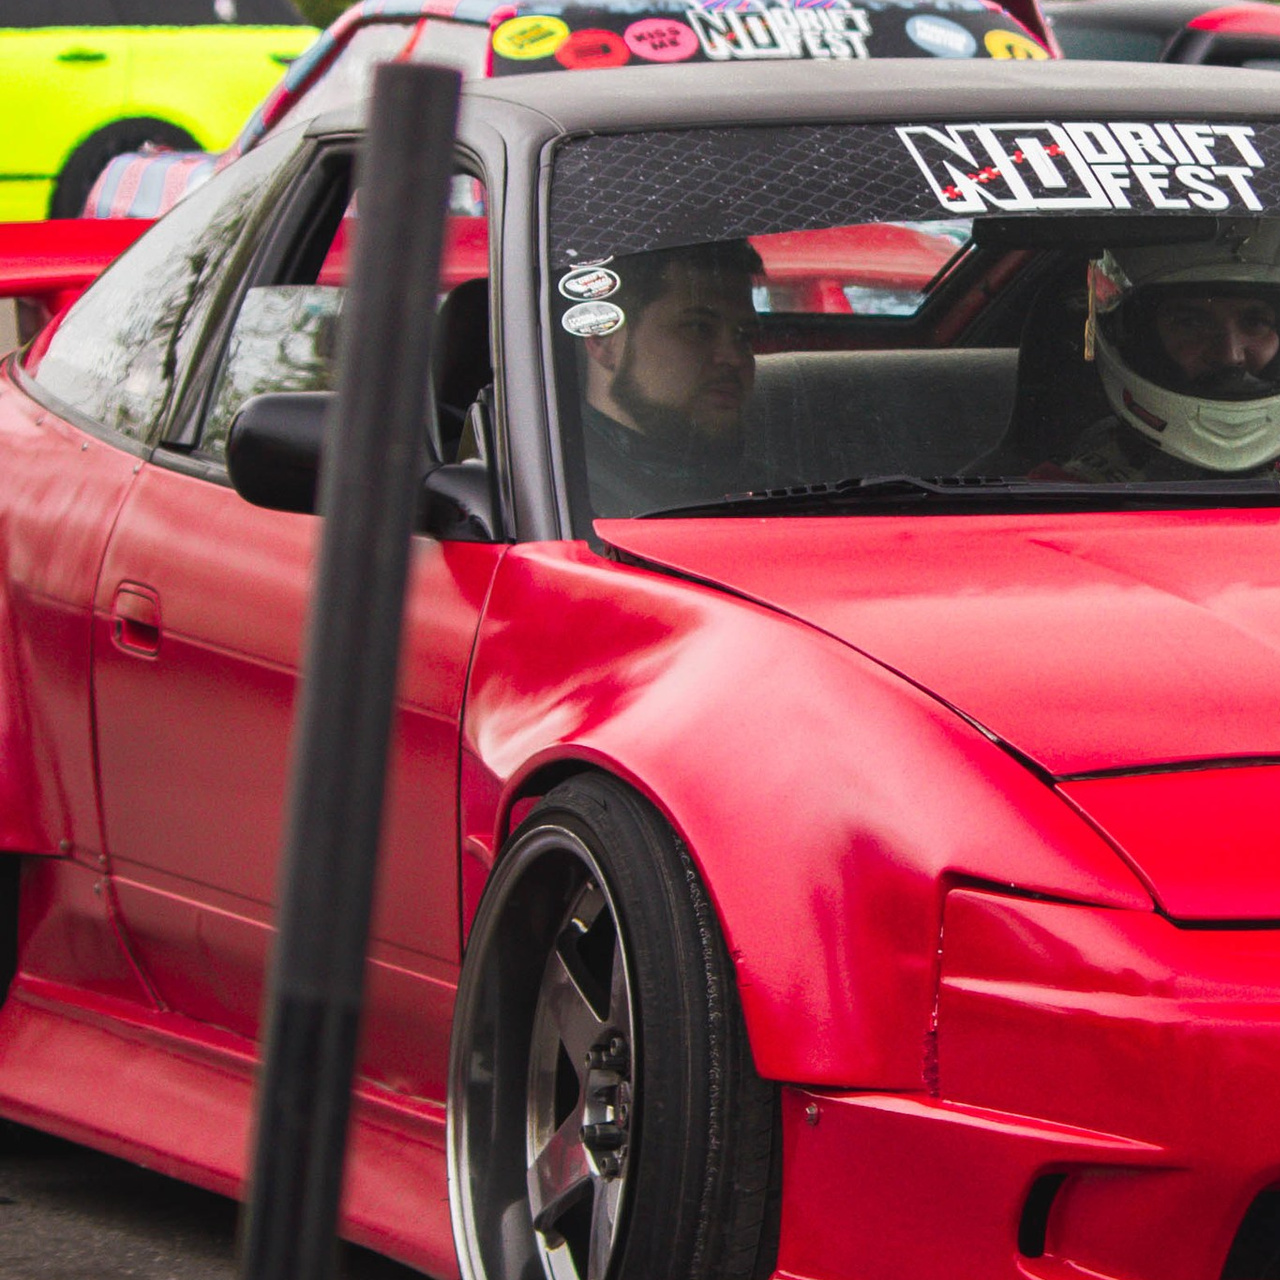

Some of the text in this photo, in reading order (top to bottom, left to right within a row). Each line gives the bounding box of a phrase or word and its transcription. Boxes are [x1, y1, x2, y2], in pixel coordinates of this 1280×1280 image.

[633, 27, 681, 43] KISS
[771, 7, 873, 36] DRIFT
[650, 37, 681, 51] ME
[782, 31, 870, 61] FEST
[895, 122, 1266, 213] NO DRIFT
[1090, 164, 1263, 212] FEST
